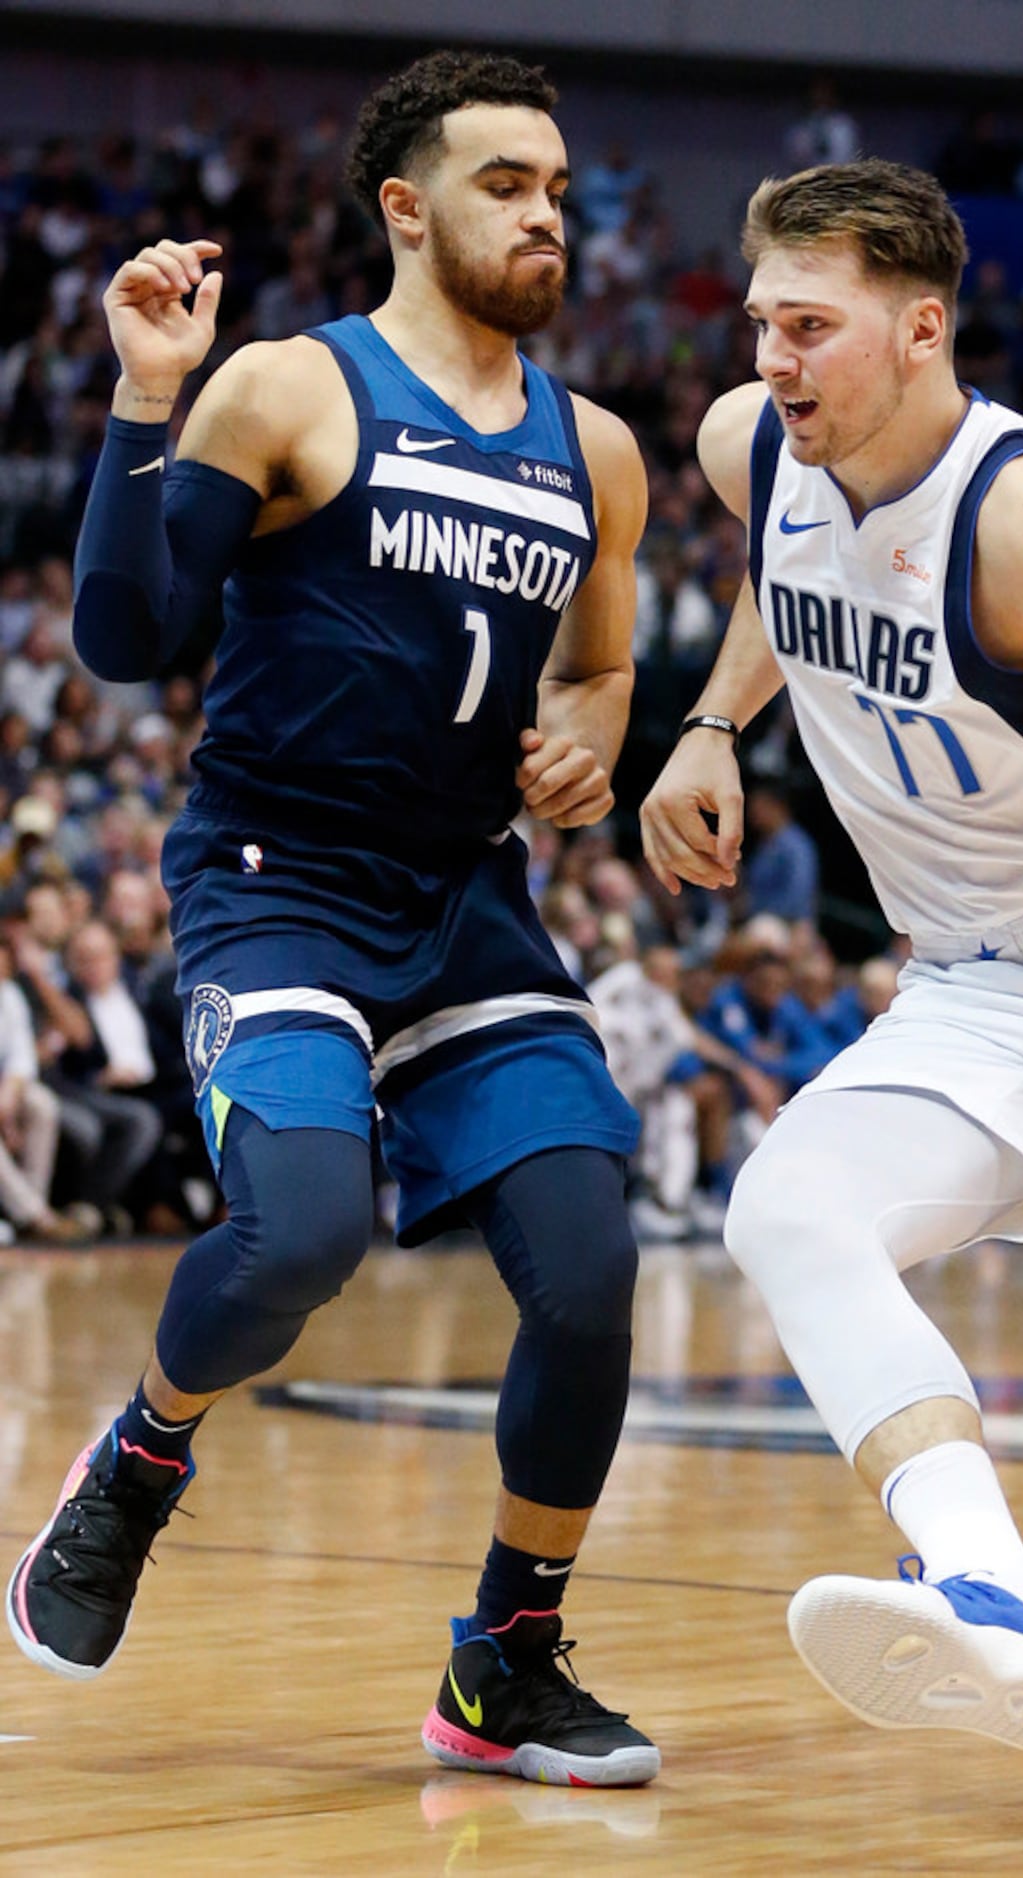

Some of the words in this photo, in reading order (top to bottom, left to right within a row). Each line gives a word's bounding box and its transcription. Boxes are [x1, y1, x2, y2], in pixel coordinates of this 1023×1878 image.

[534, 464, 573, 493] fitbit
[453, 608, 491, 724] 1
[769, 581, 938, 701] DALLAS
[854, 694, 982, 798] 77
